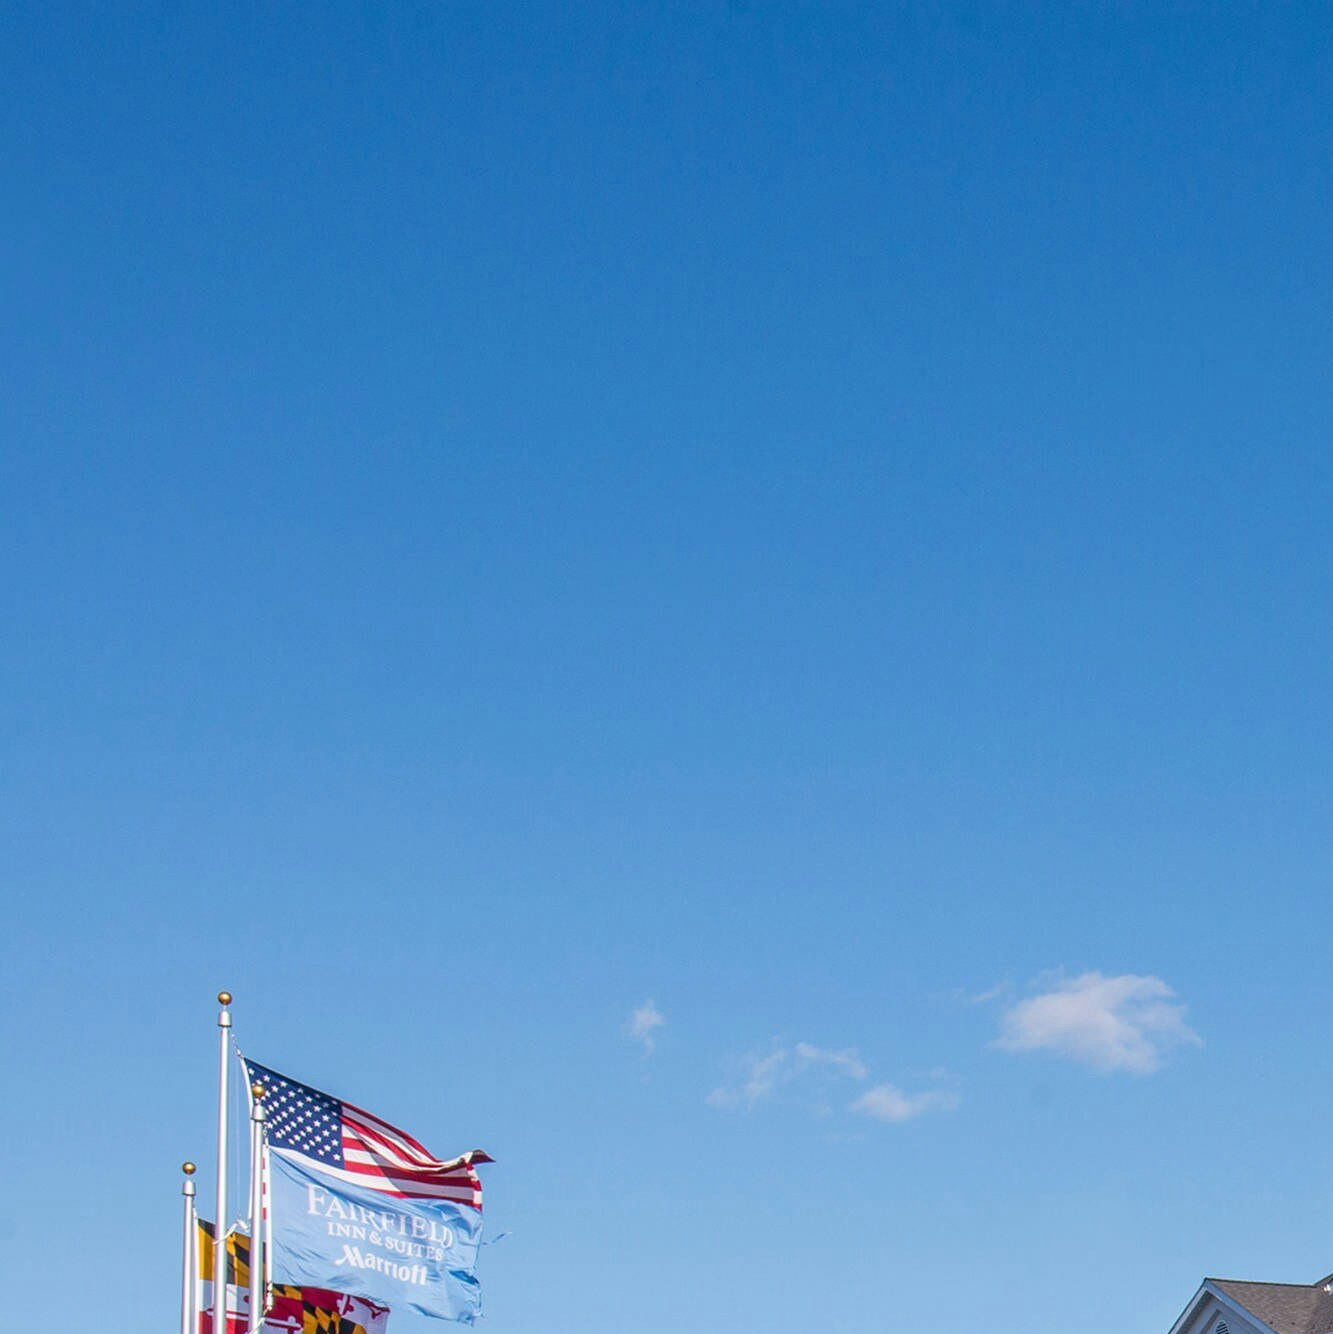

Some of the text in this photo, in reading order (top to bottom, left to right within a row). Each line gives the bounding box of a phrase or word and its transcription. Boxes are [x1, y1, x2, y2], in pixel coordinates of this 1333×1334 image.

[306, 1182, 453, 1249] FAIRFIELD
[327, 1221, 444, 1262] INN & SUITES
[334, 1243, 428, 1285] Marriott
